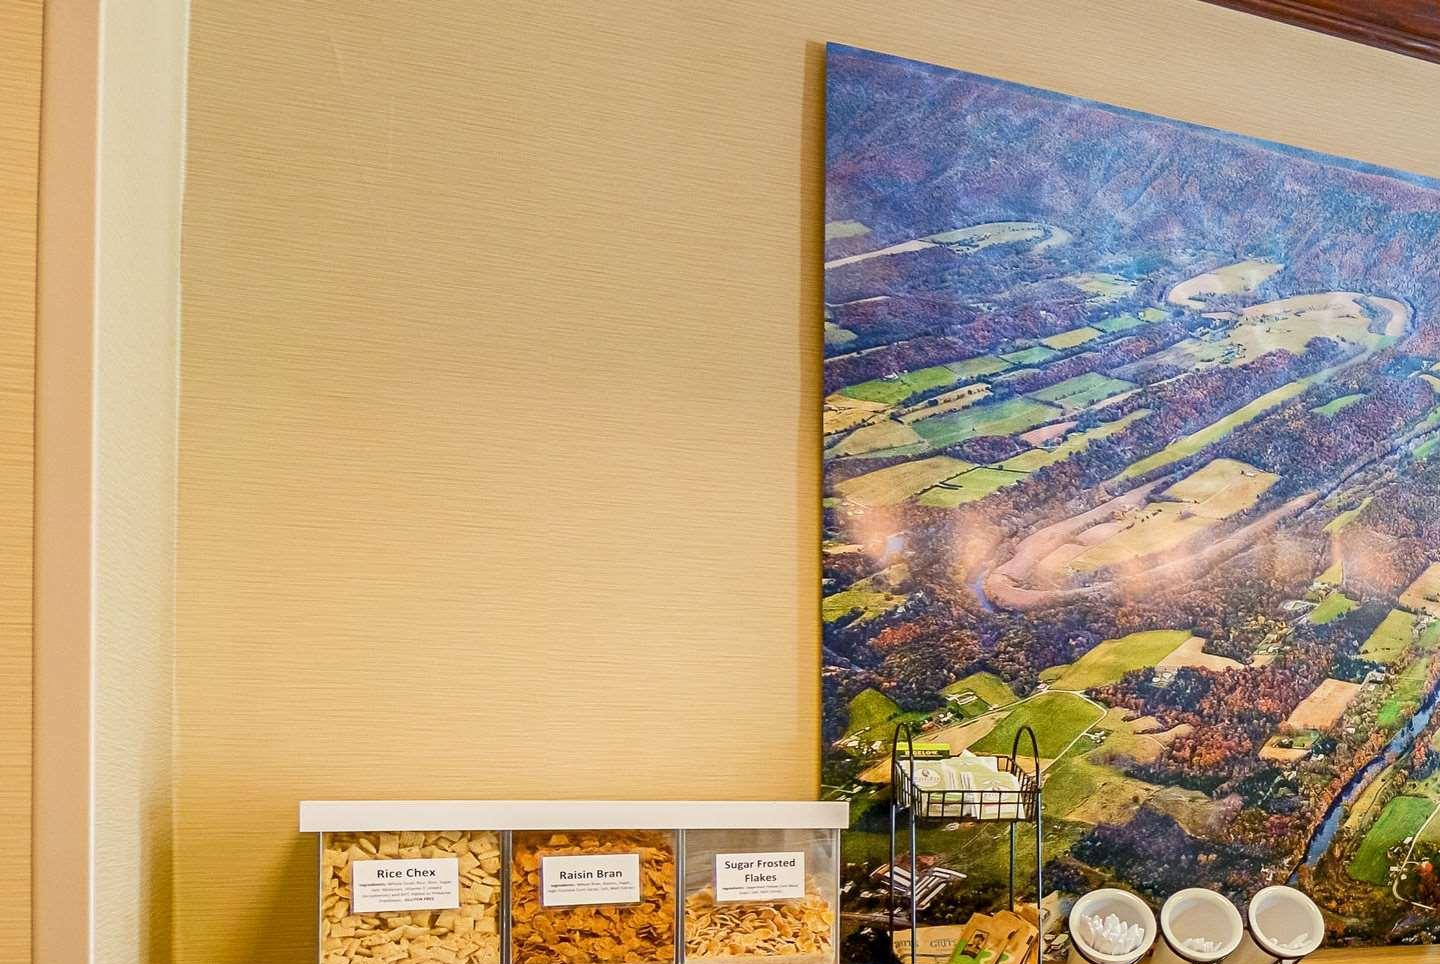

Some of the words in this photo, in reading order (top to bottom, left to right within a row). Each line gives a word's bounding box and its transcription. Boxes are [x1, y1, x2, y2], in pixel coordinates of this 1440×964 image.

[724, 860, 754, 870] Sugar
[757, 859, 796, 868] Frosted
[377, 869, 402, 878] Rice
[406, 868, 436, 878] Chex
[559, 870, 593, 880] Raisin
[596, 869, 623, 879] Bran
[744, 873, 777, 883] Flakes
